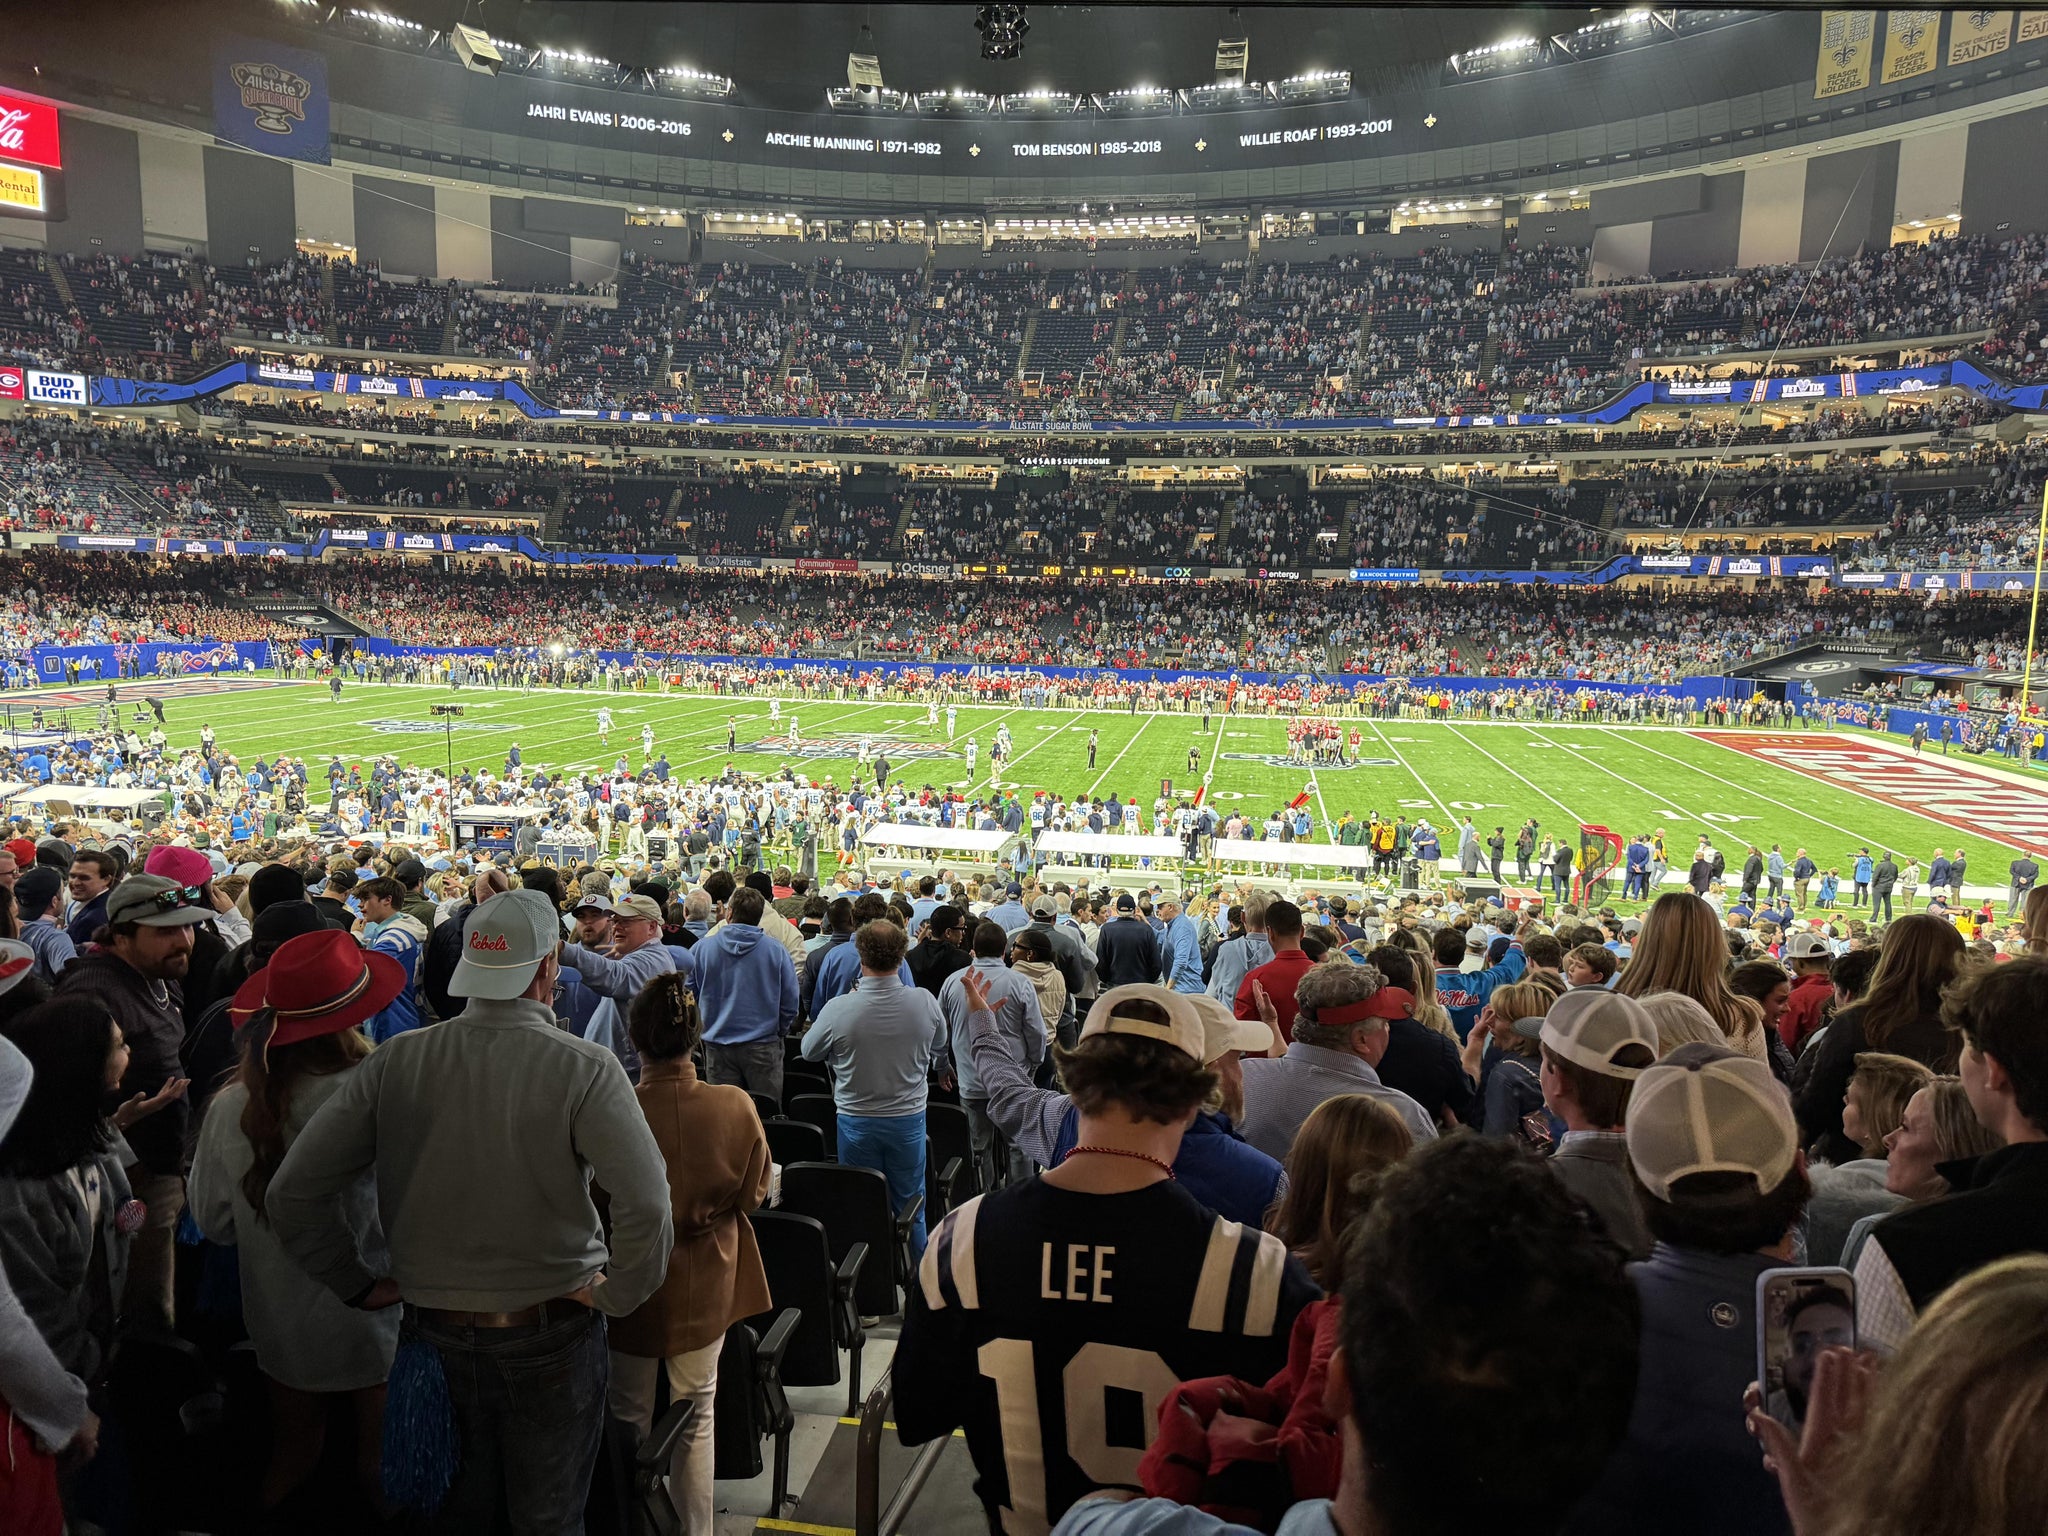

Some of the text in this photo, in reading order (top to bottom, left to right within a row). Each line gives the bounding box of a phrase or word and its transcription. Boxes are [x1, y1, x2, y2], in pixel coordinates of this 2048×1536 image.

[1952, 36, 2007, 62] SAINTS
[1894, 57, 1926, 70] TICKET
[1895, 50, 1926, 64] SEASON
[1827, 68, 1858, 80] SEASON
[1888, 62, 1929, 80] HOLDERS
[244, 75, 296, 96] Allstate
[1820, 78, 1862, 95] HOLDERS
[1827, 74, 1858, 86] TICKET
[526, 103, 692, 136] JAHRI EVANS 2006-2016
[1239, 119, 1393, 147] WILLIE ROAF 1993-2001
[765, 132, 942, 155] ARCHIE MANNING 1971-1982
[1012, 140, 1162, 156] TOM BENSON 1985-2018
[39, 375, 75, 389] BUD
[33, 386, 82, 400] LIGHT
[1010, 421, 1094, 431] ALLSTATE SUGAR BOWL
[1019, 457, 1111, 467] CAESARS SUPERDOME
[719, 558, 752, 567] Allstate
[799, 558, 836, 570] Community
[901, 562, 951, 574] Ochsner
[996, 565, 1007, 574] 39
[1043, 566, 1061, 575] 0:00
[1092, 566, 1103, 576] 34
[1164, 567, 1192, 577] COX
[1268, 571, 1300, 580] entergy
[1389, 571, 1419, 579] WHITNEY
[1854, 646, 1889, 655] SUPERDOME
[468, 929, 511, 952] Rebels
[1448, 988, 1480, 1008] Miss
[1040, 1241, 1117, 1304] LEE
